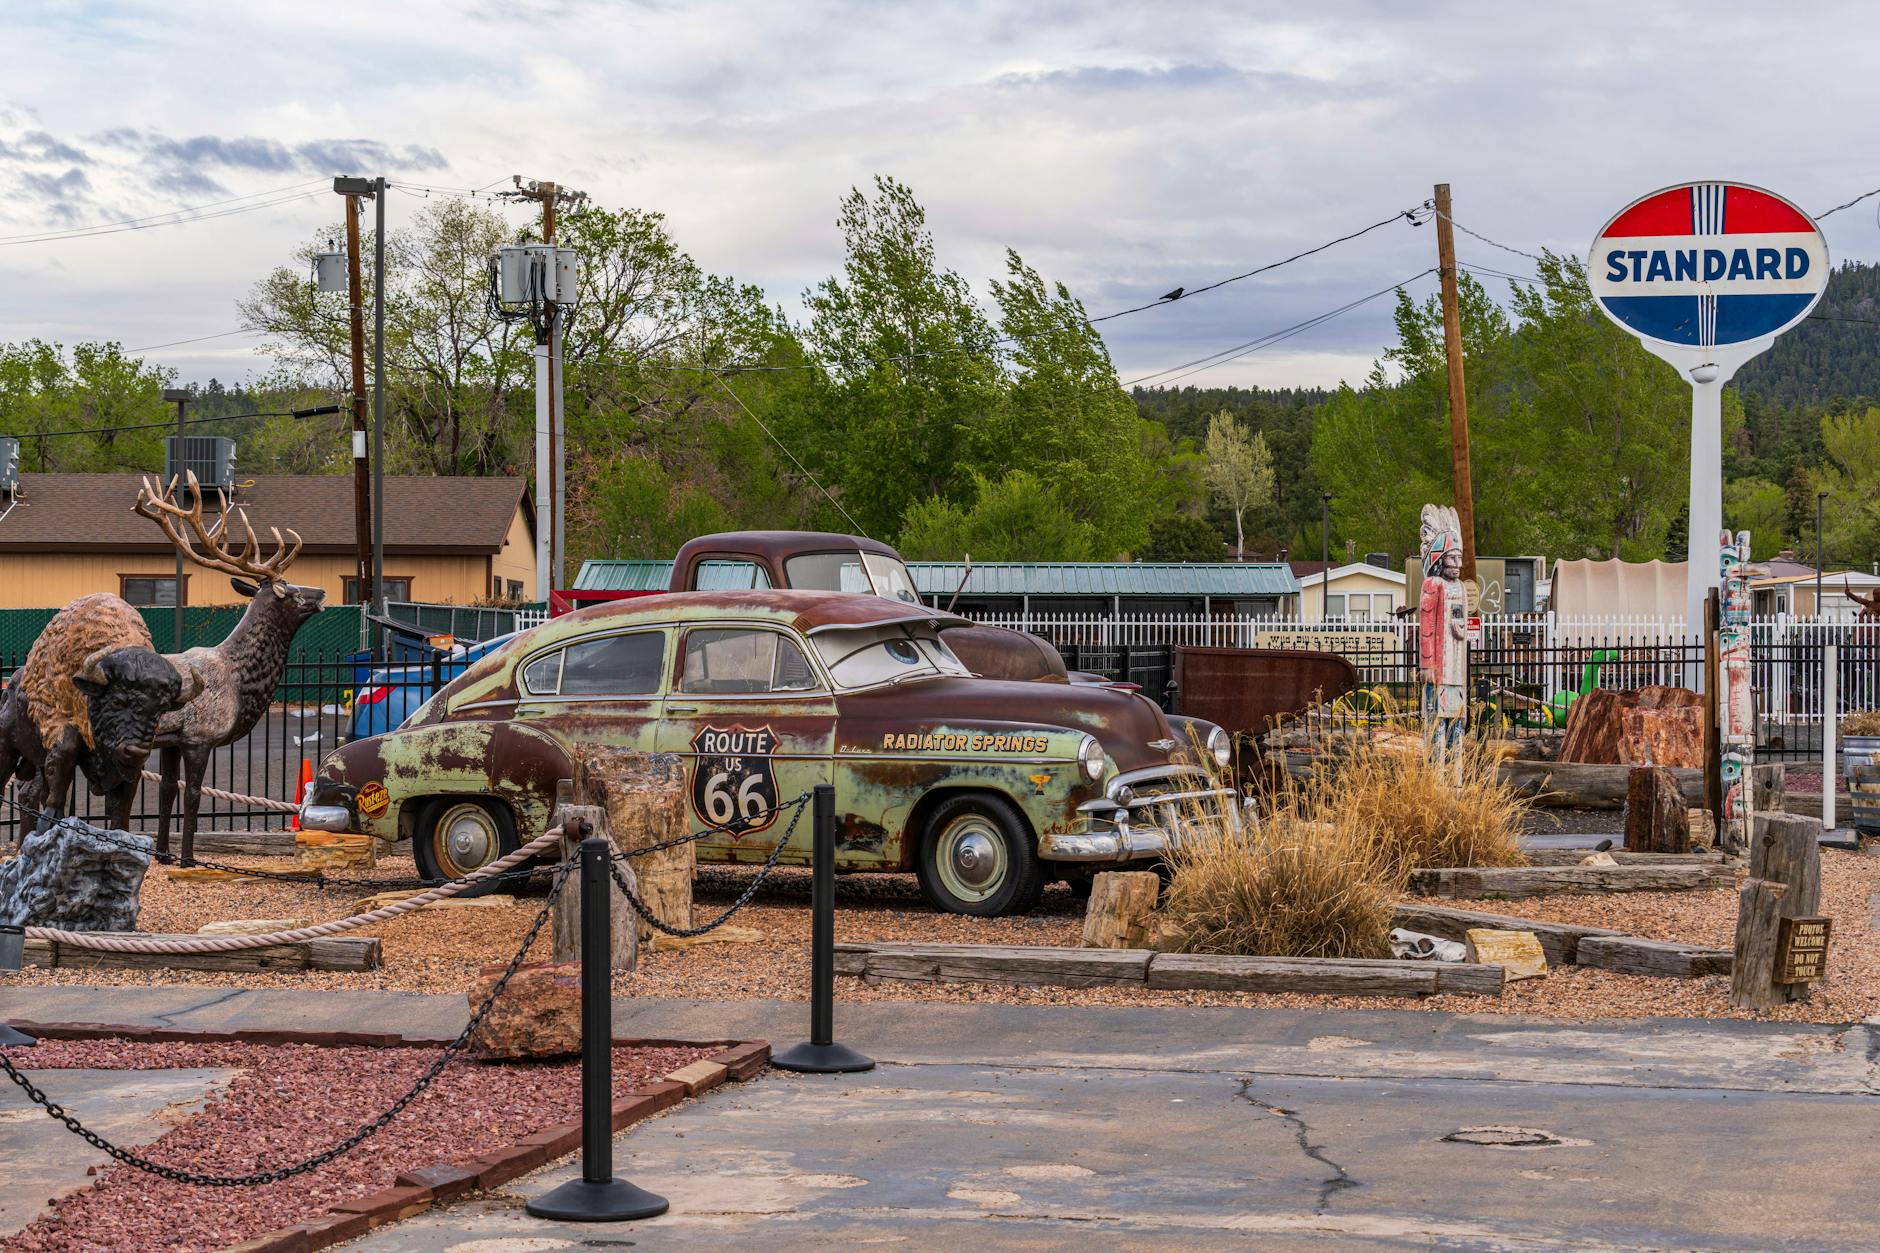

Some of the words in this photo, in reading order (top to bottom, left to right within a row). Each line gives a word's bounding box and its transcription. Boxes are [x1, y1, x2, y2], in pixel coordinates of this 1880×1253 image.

[1606, 247, 1810, 282] STANDARD
[704, 733, 768, 753] ROUTE
[883, 733, 968, 751] RADIATOR
[971, 735, 1049, 752] SPRINGS
[725, 757, 742, 772] US
[704, 772, 768, 827] 66
[1799, 924, 1824, 935] PHOTOS
[1794, 936, 1825, 946] WELCOME
[1794, 954, 1804, 964] DO
[1805, 954, 1819, 964] NOT
[1795, 966, 1816, 976] TOUCH
